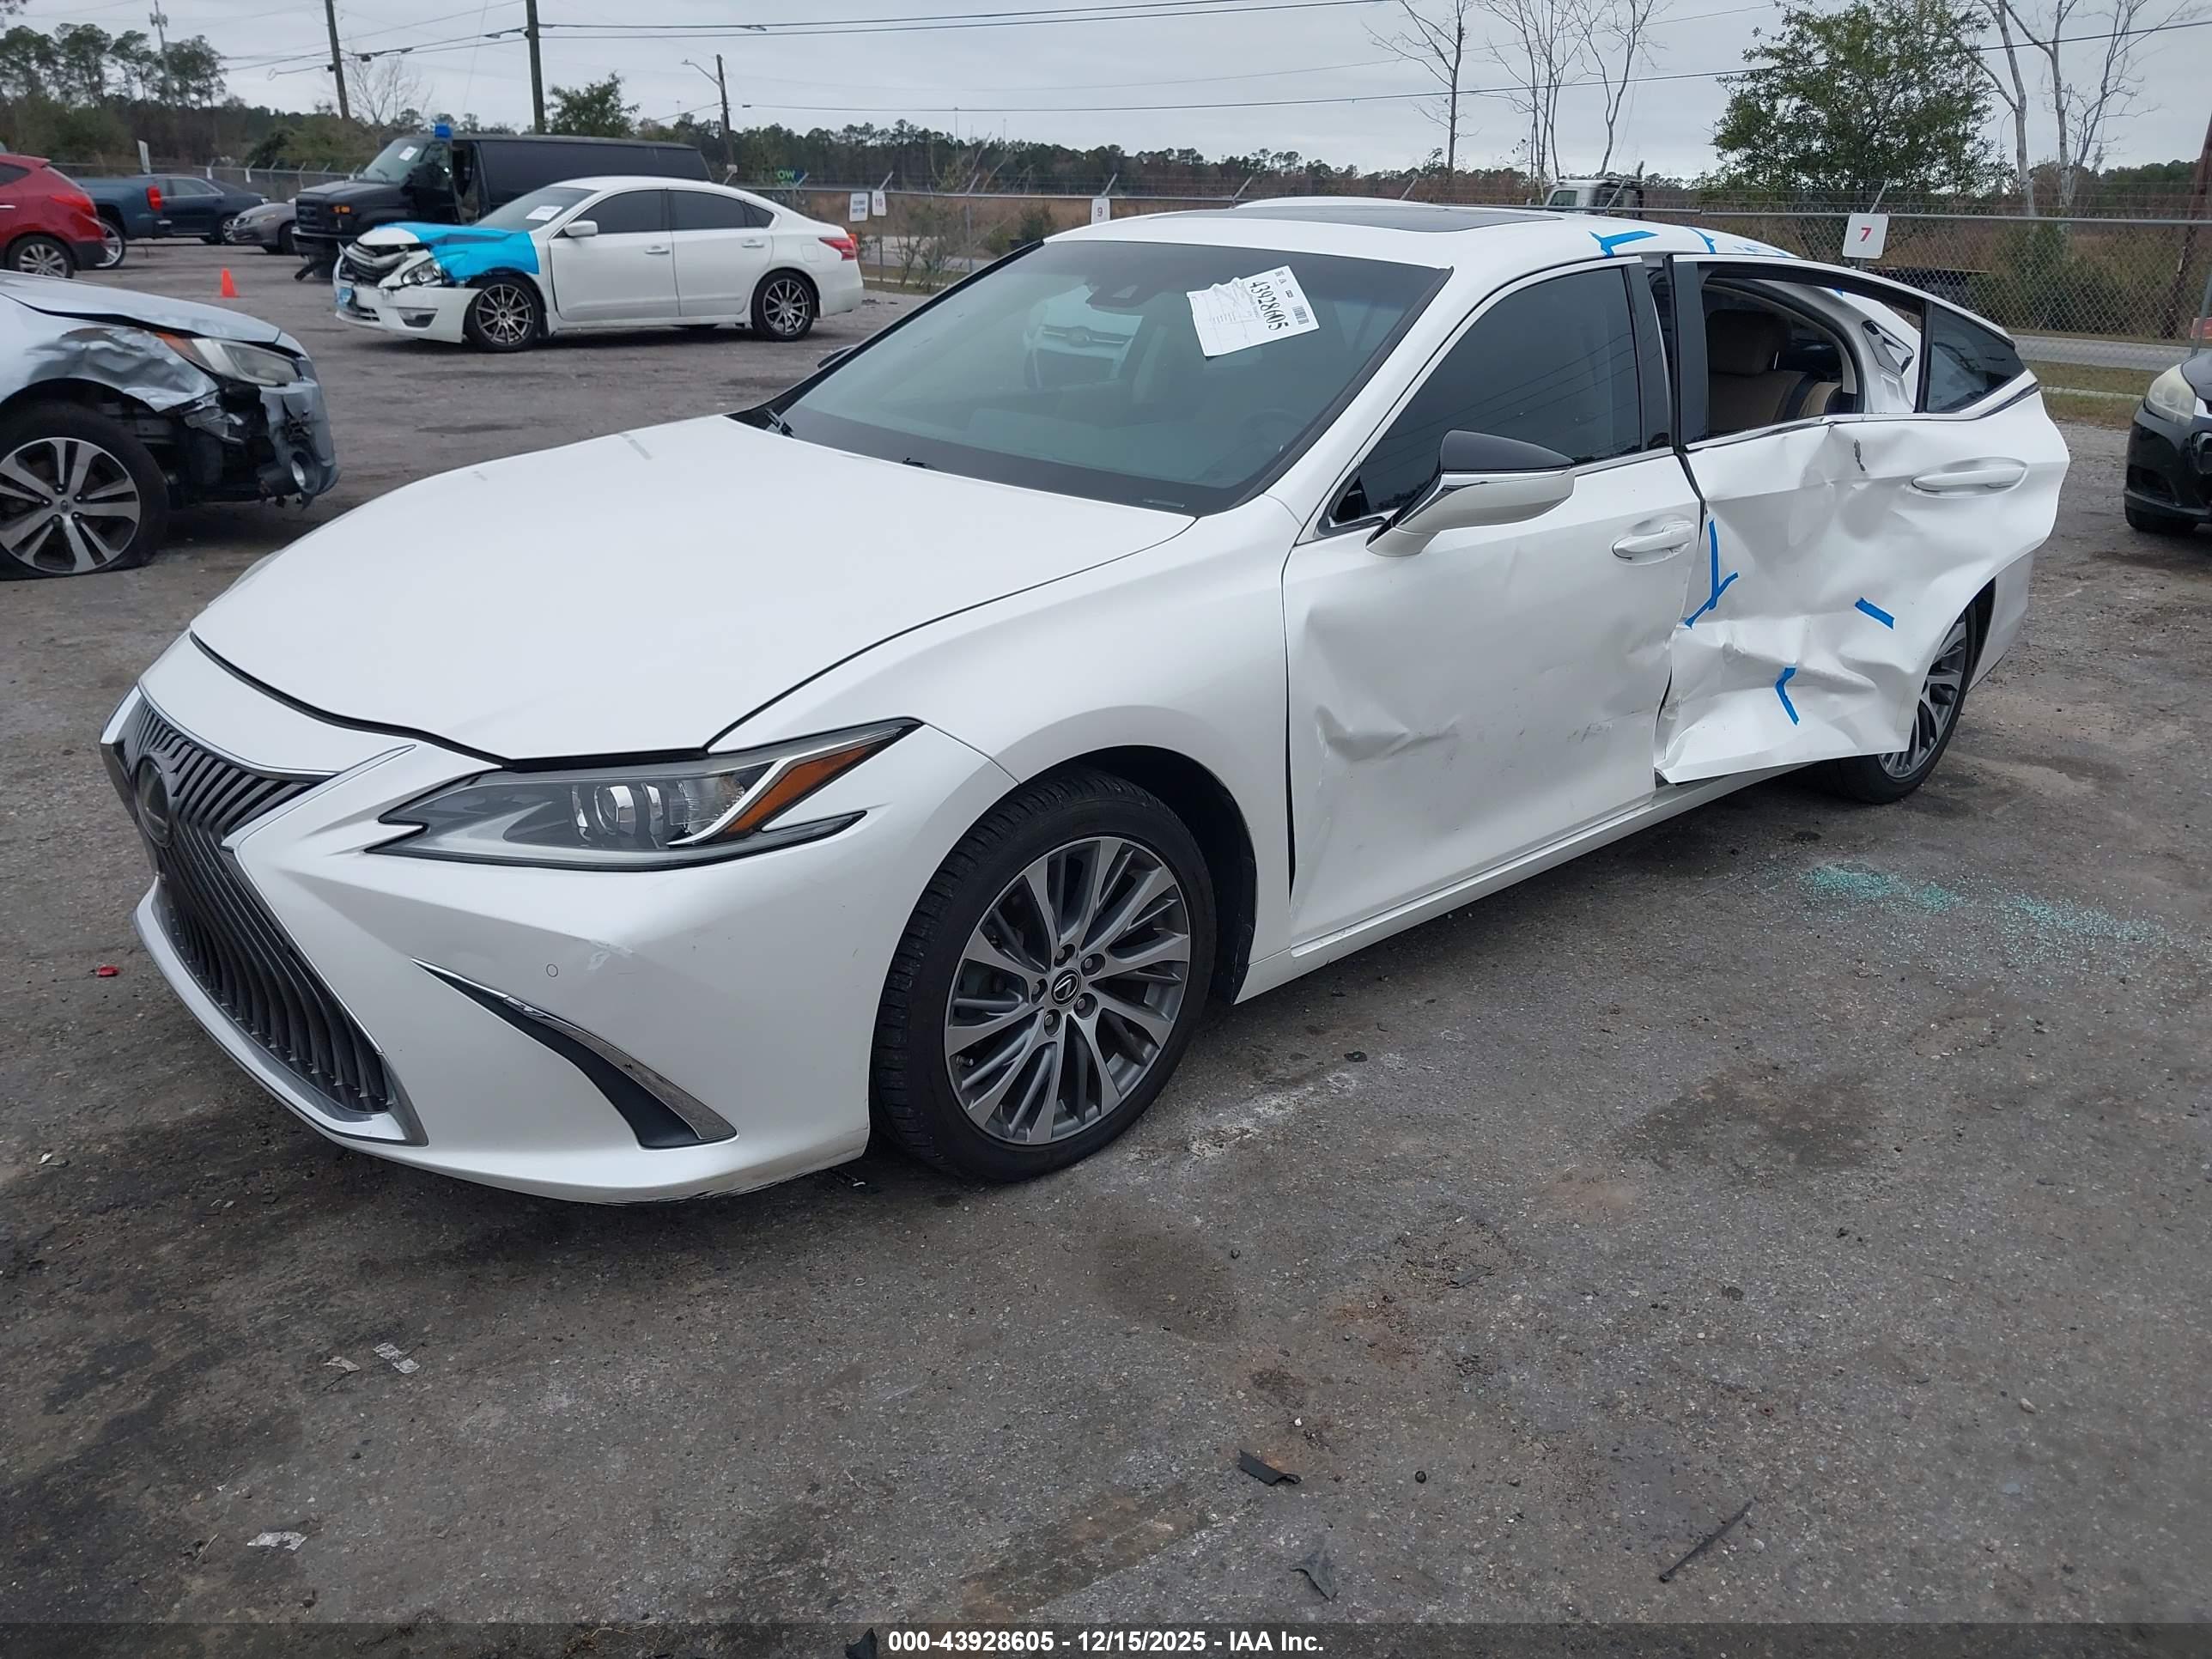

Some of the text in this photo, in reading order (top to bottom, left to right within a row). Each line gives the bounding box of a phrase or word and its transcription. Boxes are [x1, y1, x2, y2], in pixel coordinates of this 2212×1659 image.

[1097, 206, 1103, 216] 9
[1860, 227, 1872, 242] 7
[1249, 281, 1289, 331] 43928605
